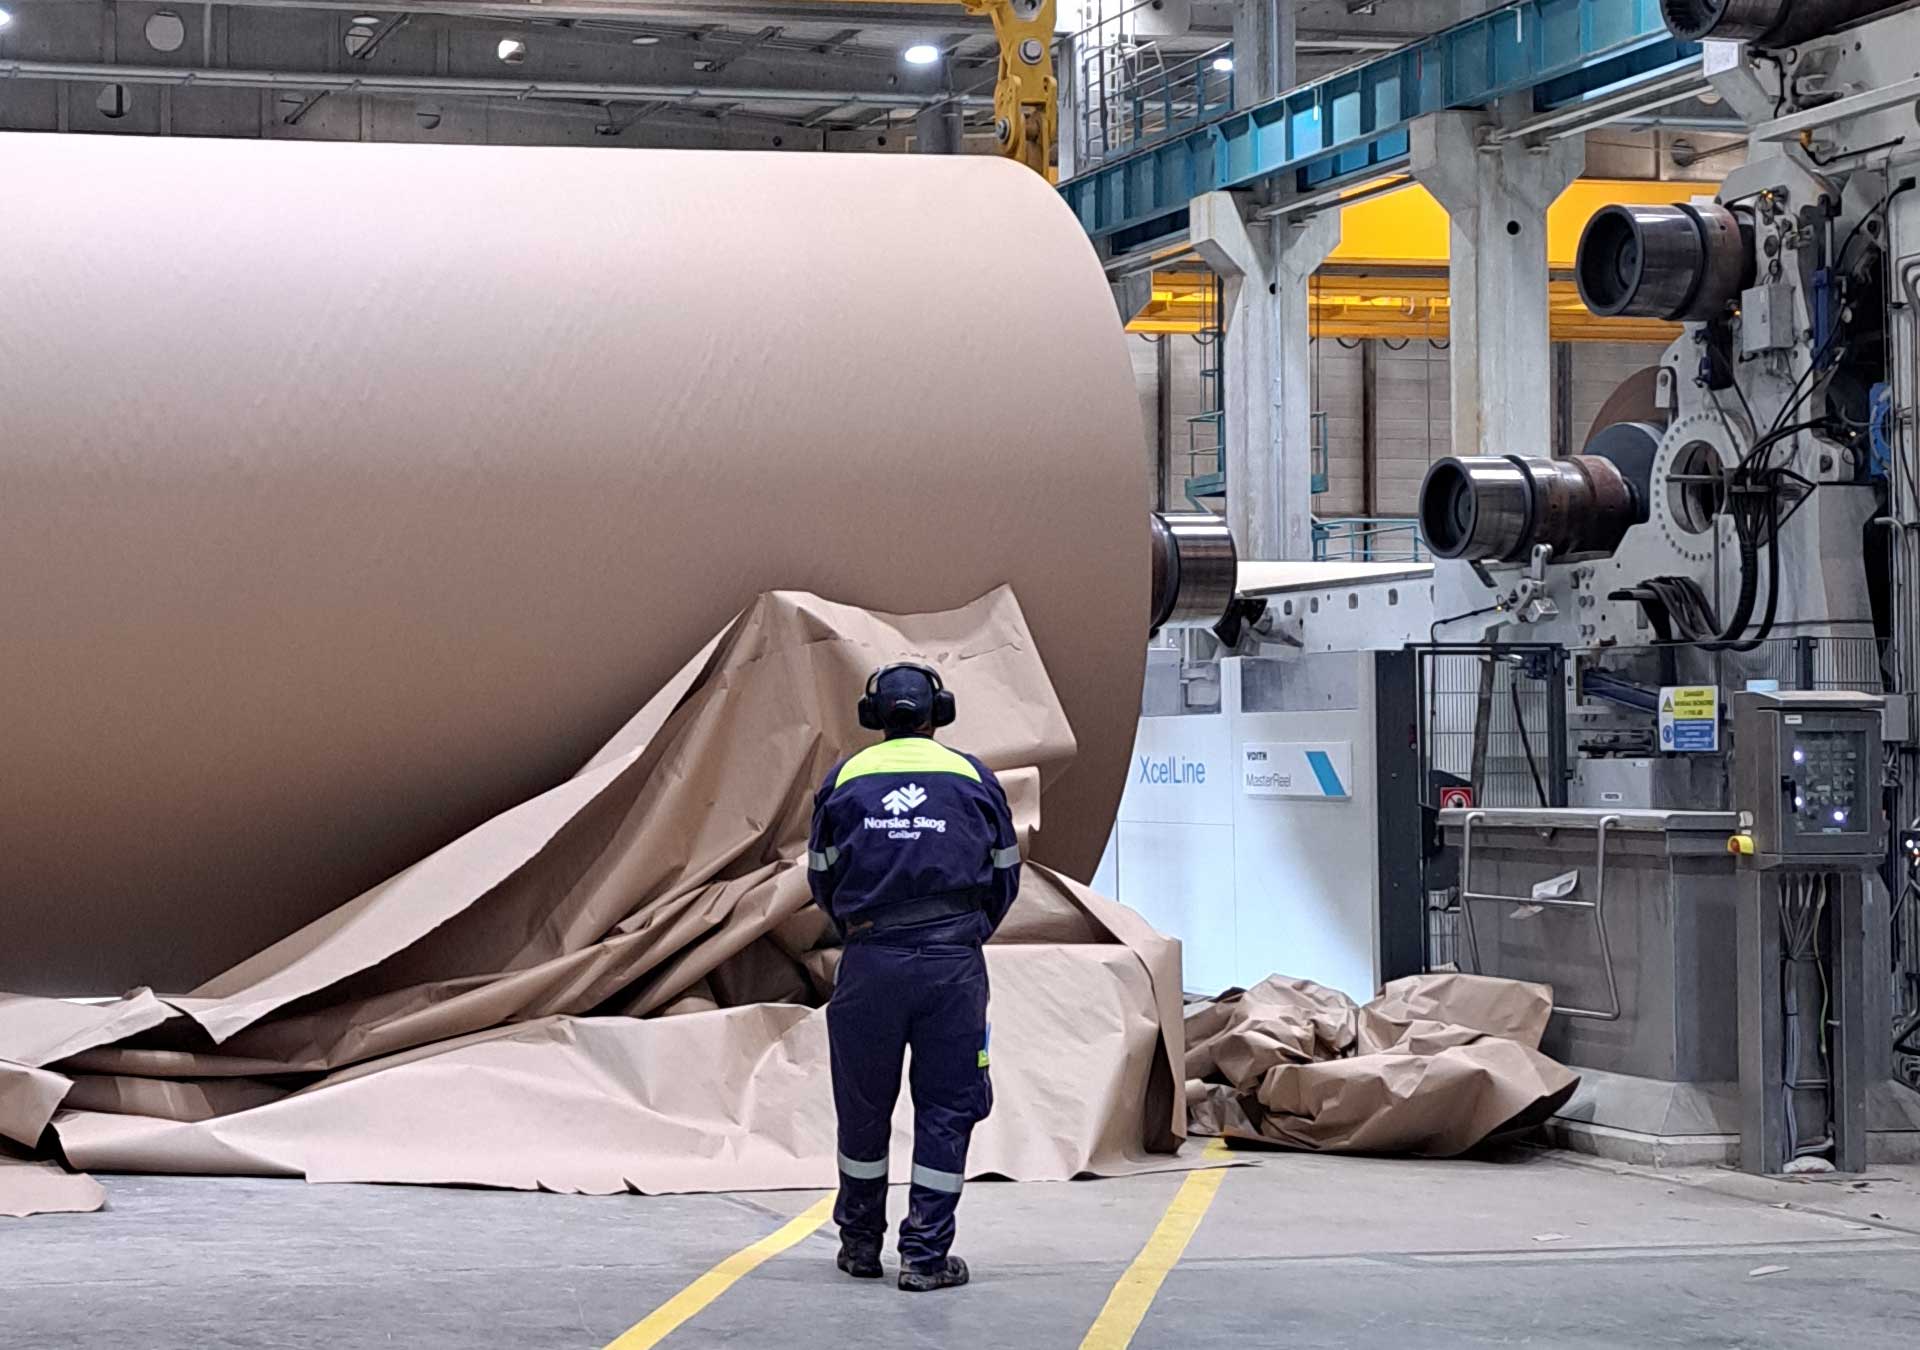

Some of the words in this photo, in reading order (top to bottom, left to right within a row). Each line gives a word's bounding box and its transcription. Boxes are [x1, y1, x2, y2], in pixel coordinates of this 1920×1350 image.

[1246, 751, 1267, 761] VOITH
[1139, 755, 1206, 784] XcelLine
[1246, 773, 1291, 788] MasterReel
[864, 817, 910, 829] Norske
[913, 816, 946, 832] Skog
